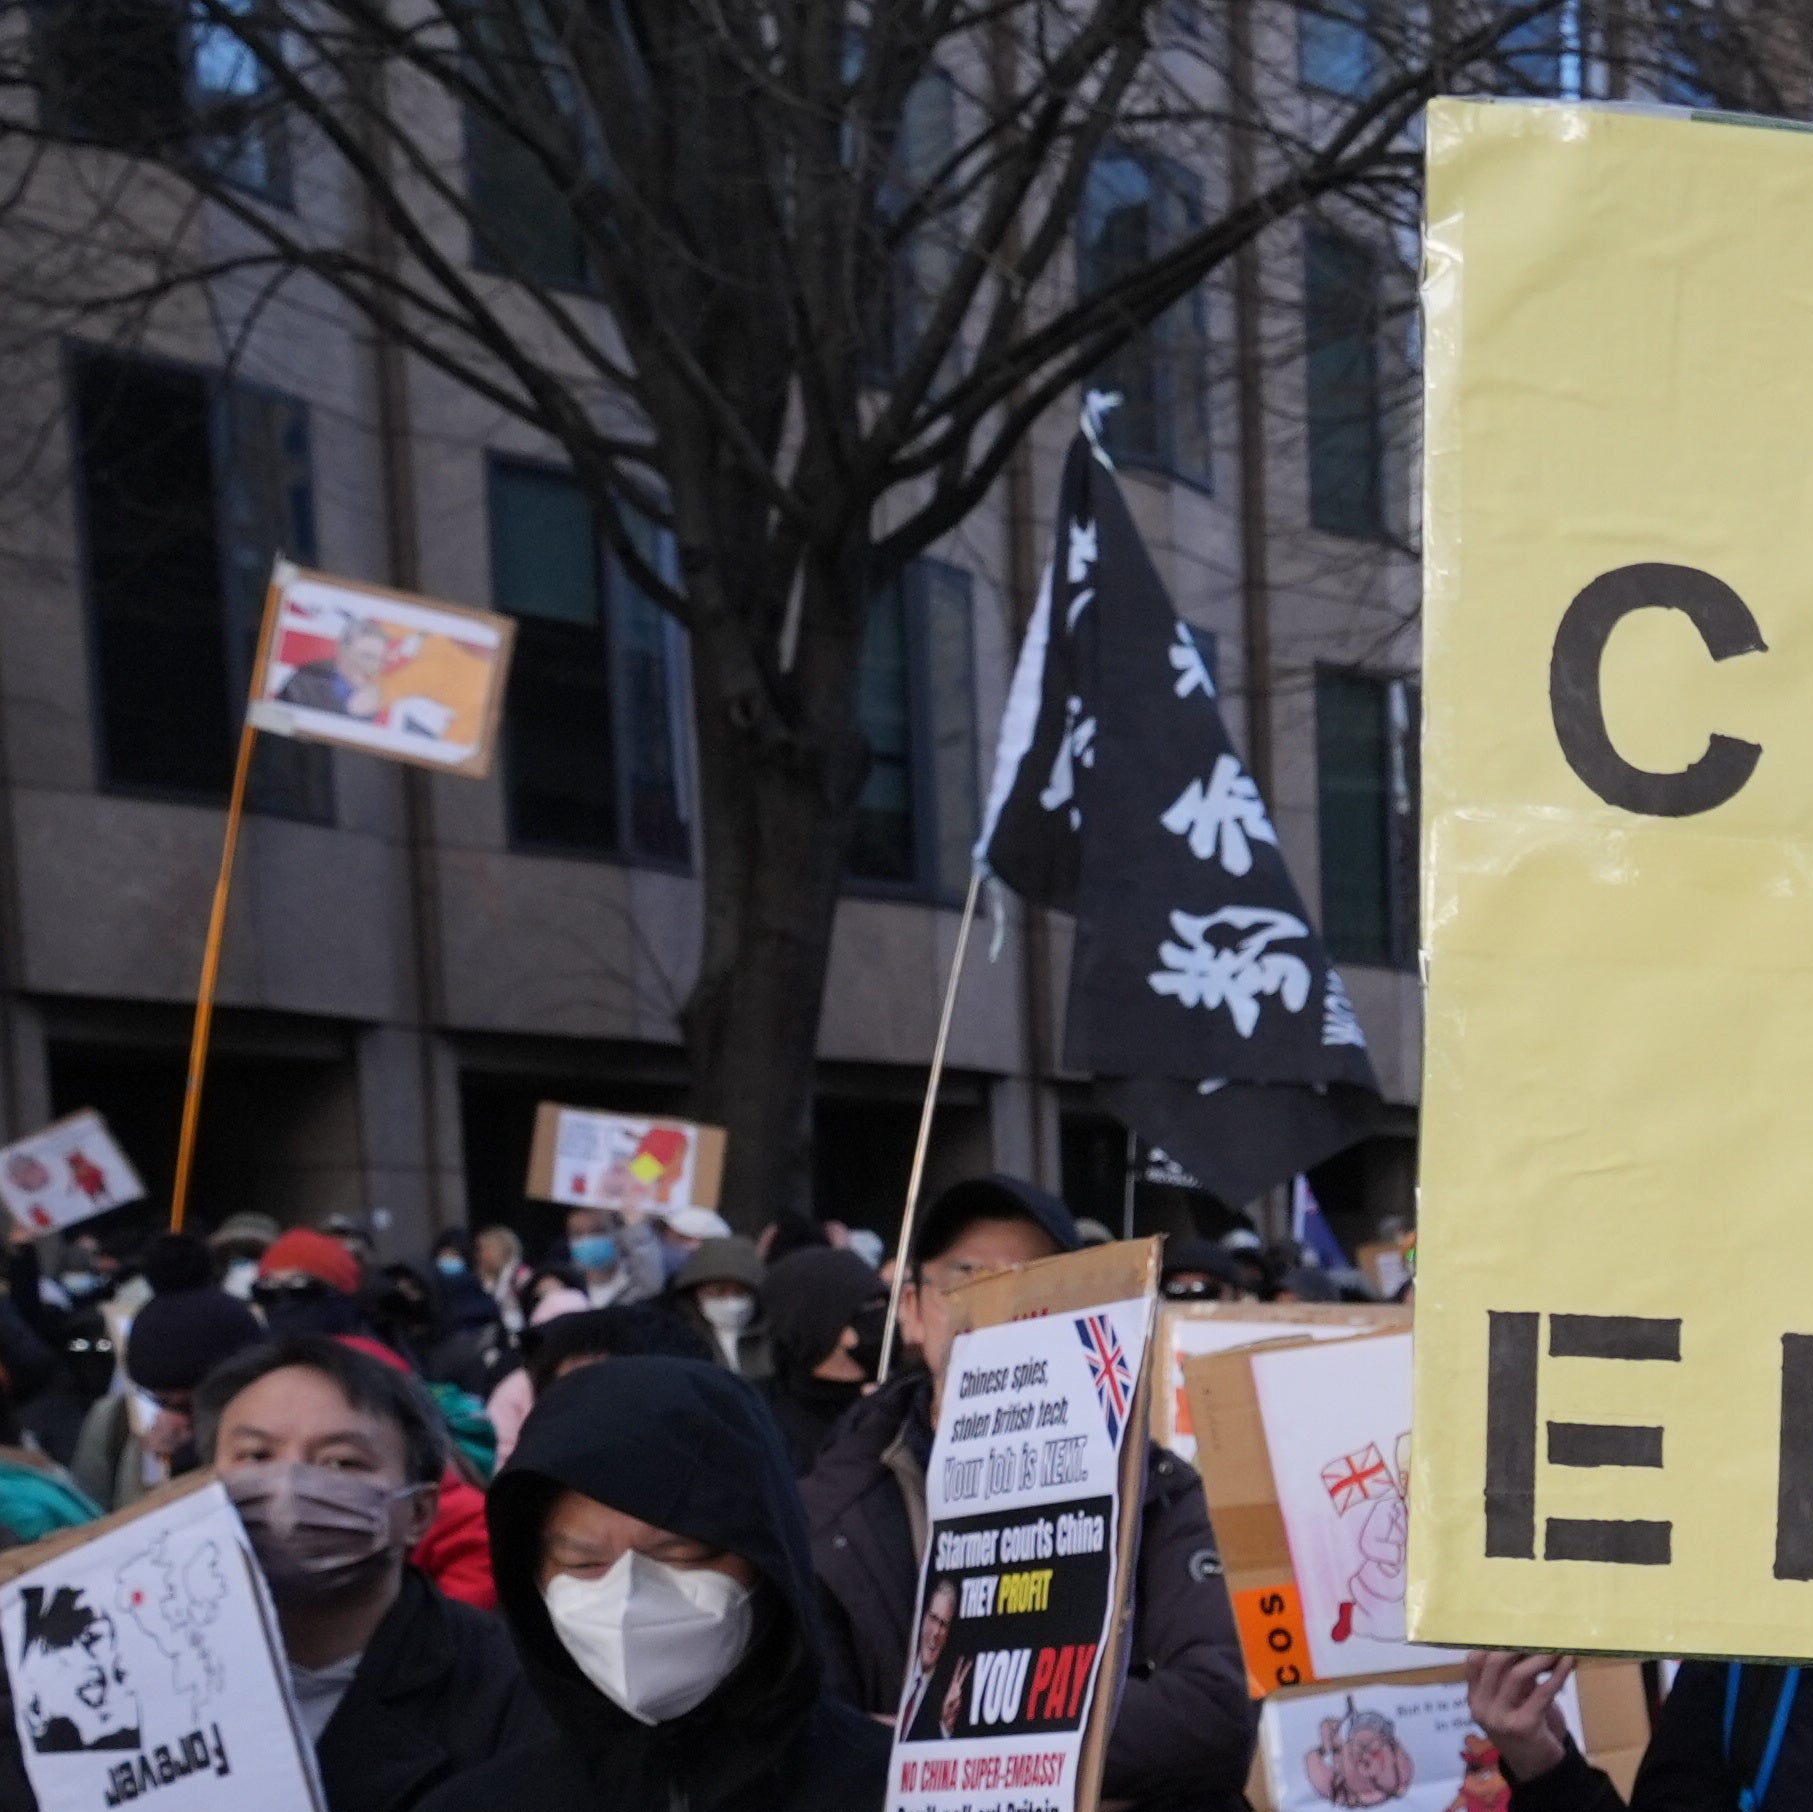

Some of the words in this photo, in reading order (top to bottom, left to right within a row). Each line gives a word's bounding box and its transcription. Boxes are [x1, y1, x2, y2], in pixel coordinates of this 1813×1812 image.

[959, 1366, 1008, 1399] Chinese
[1011, 1360, 1048, 1394] spies,
[951, 1409, 992, 1443] stolen
[992, 1402, 1034, 1436] British
[1036, 1397, 1069, 1429] tech,
[943, 1457, 983, 1502] Your
[984, 1446, 1017, 1500] job
[1019, 1443, 1037, 1491] is
[1040, 1435, 1089, 1487] NEXT.
[935, 1527, 999, 1572] Starmer
[1000, 1517, 1054, 1565] courts
[1056, 1509, 1104, 1556] China
[959, 1574, 999, 1619] THEY
[997, 1568, 1053, 1614] PROFIT
[969, 1648, 1032, 1727] YOU
[1026, 1643, 1097, 1721] PAY
[104, 1721, 232, 1808] Forever
[899, 1761, 918, 1793] NO
[921, 1759, 960, 1792] CHINA
[962, 1752, 1066, 1791] SUPER-EMBASSY
